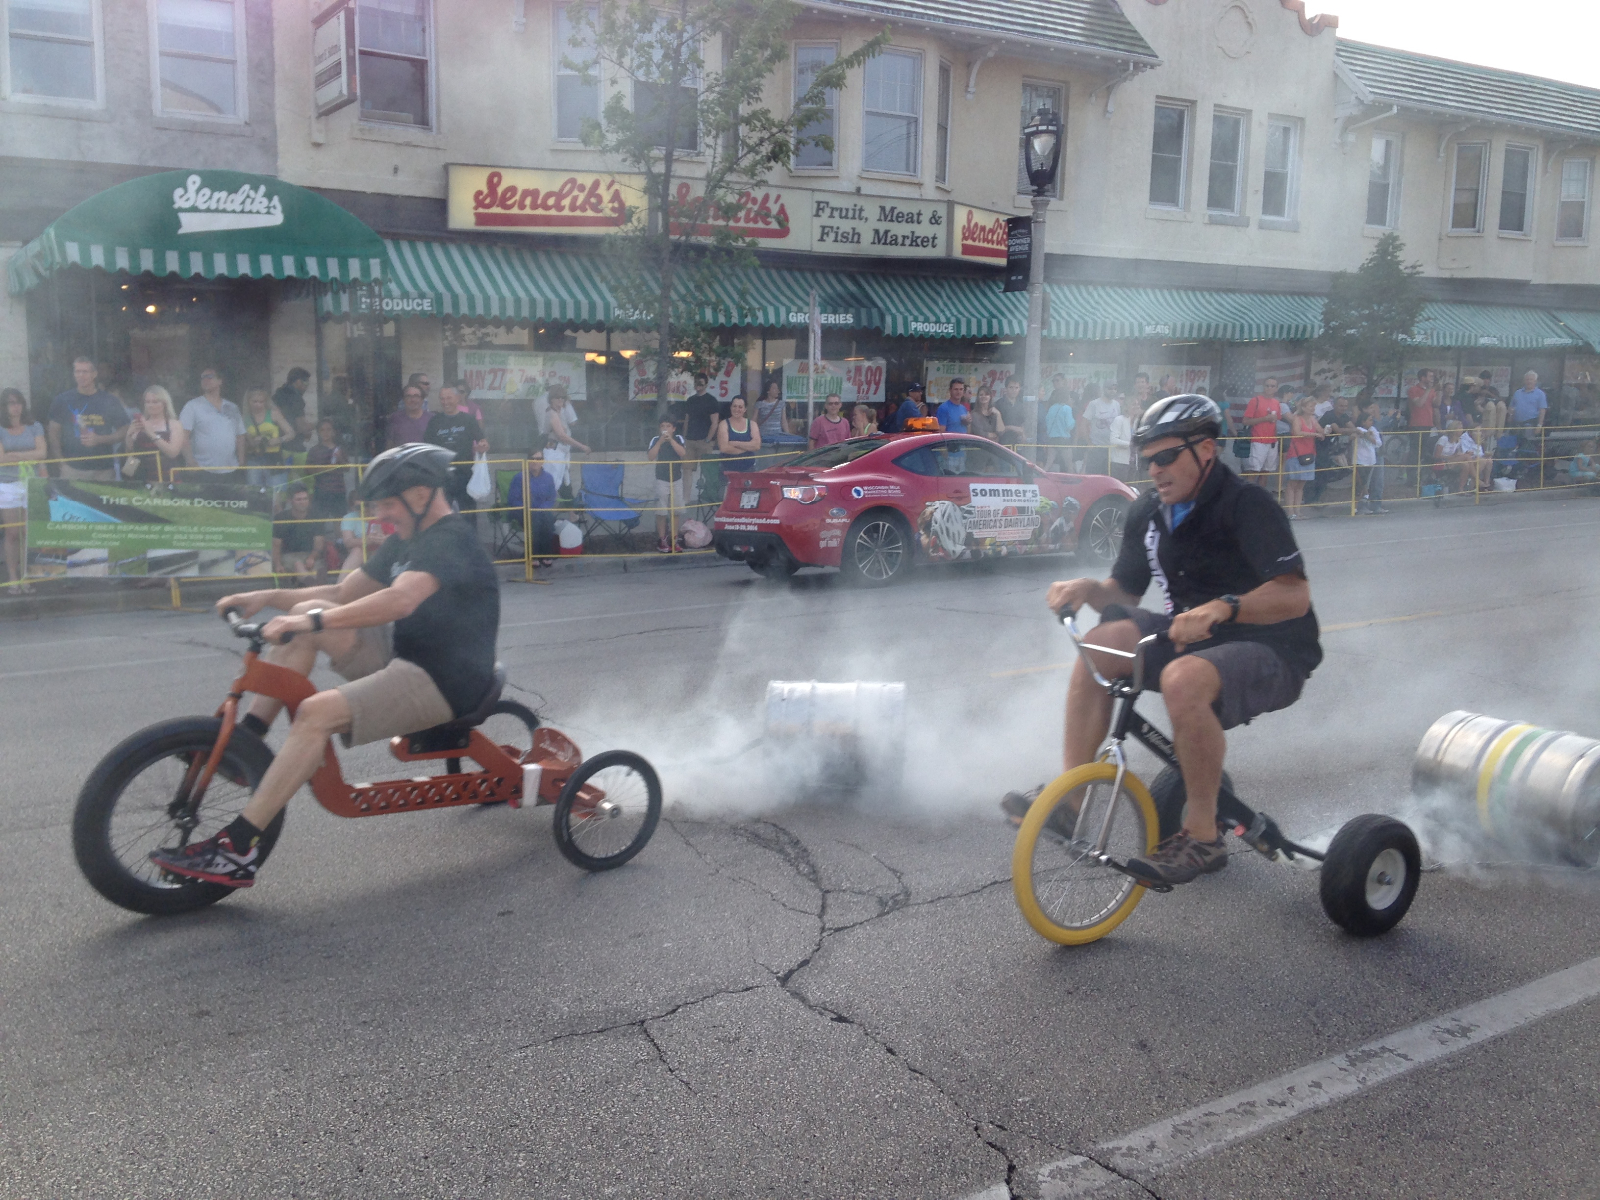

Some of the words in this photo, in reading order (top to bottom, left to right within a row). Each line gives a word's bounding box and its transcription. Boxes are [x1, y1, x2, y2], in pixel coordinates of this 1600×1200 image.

[172, 174, 284, 217] Sendiks
[472, 171, 626, 216] Sendik's
[813, 200, 870, 223] Fruit,
[876, 205, 923, 225] Meat
[928, 209, 943, 226] &
[817, 224, 862, 244] Fish
[870, 228, 938, 249] Market
[788, 311, 854, 324] GROERIES
[910, 321, 955, 333] PRODUCE
[1144, 324, 1170, 335] MEATS
[464, 368, 487, 390] MAY
[786, 375, 843, 395] WATEMELON
[971, 488, 1039, 498] sommer's
[99, 495, 128, 506] THE
[131, 496, 191, 507] CARBON
[193, 498, 249, 508] DOCTOR
[976, 508, 992, 519] TOUR
[992, 508, 1001, 518] OF
[967, 518, 1003, 530] AMERICA'S
[1003, 516, 1040, 529] DAIRYLAND
